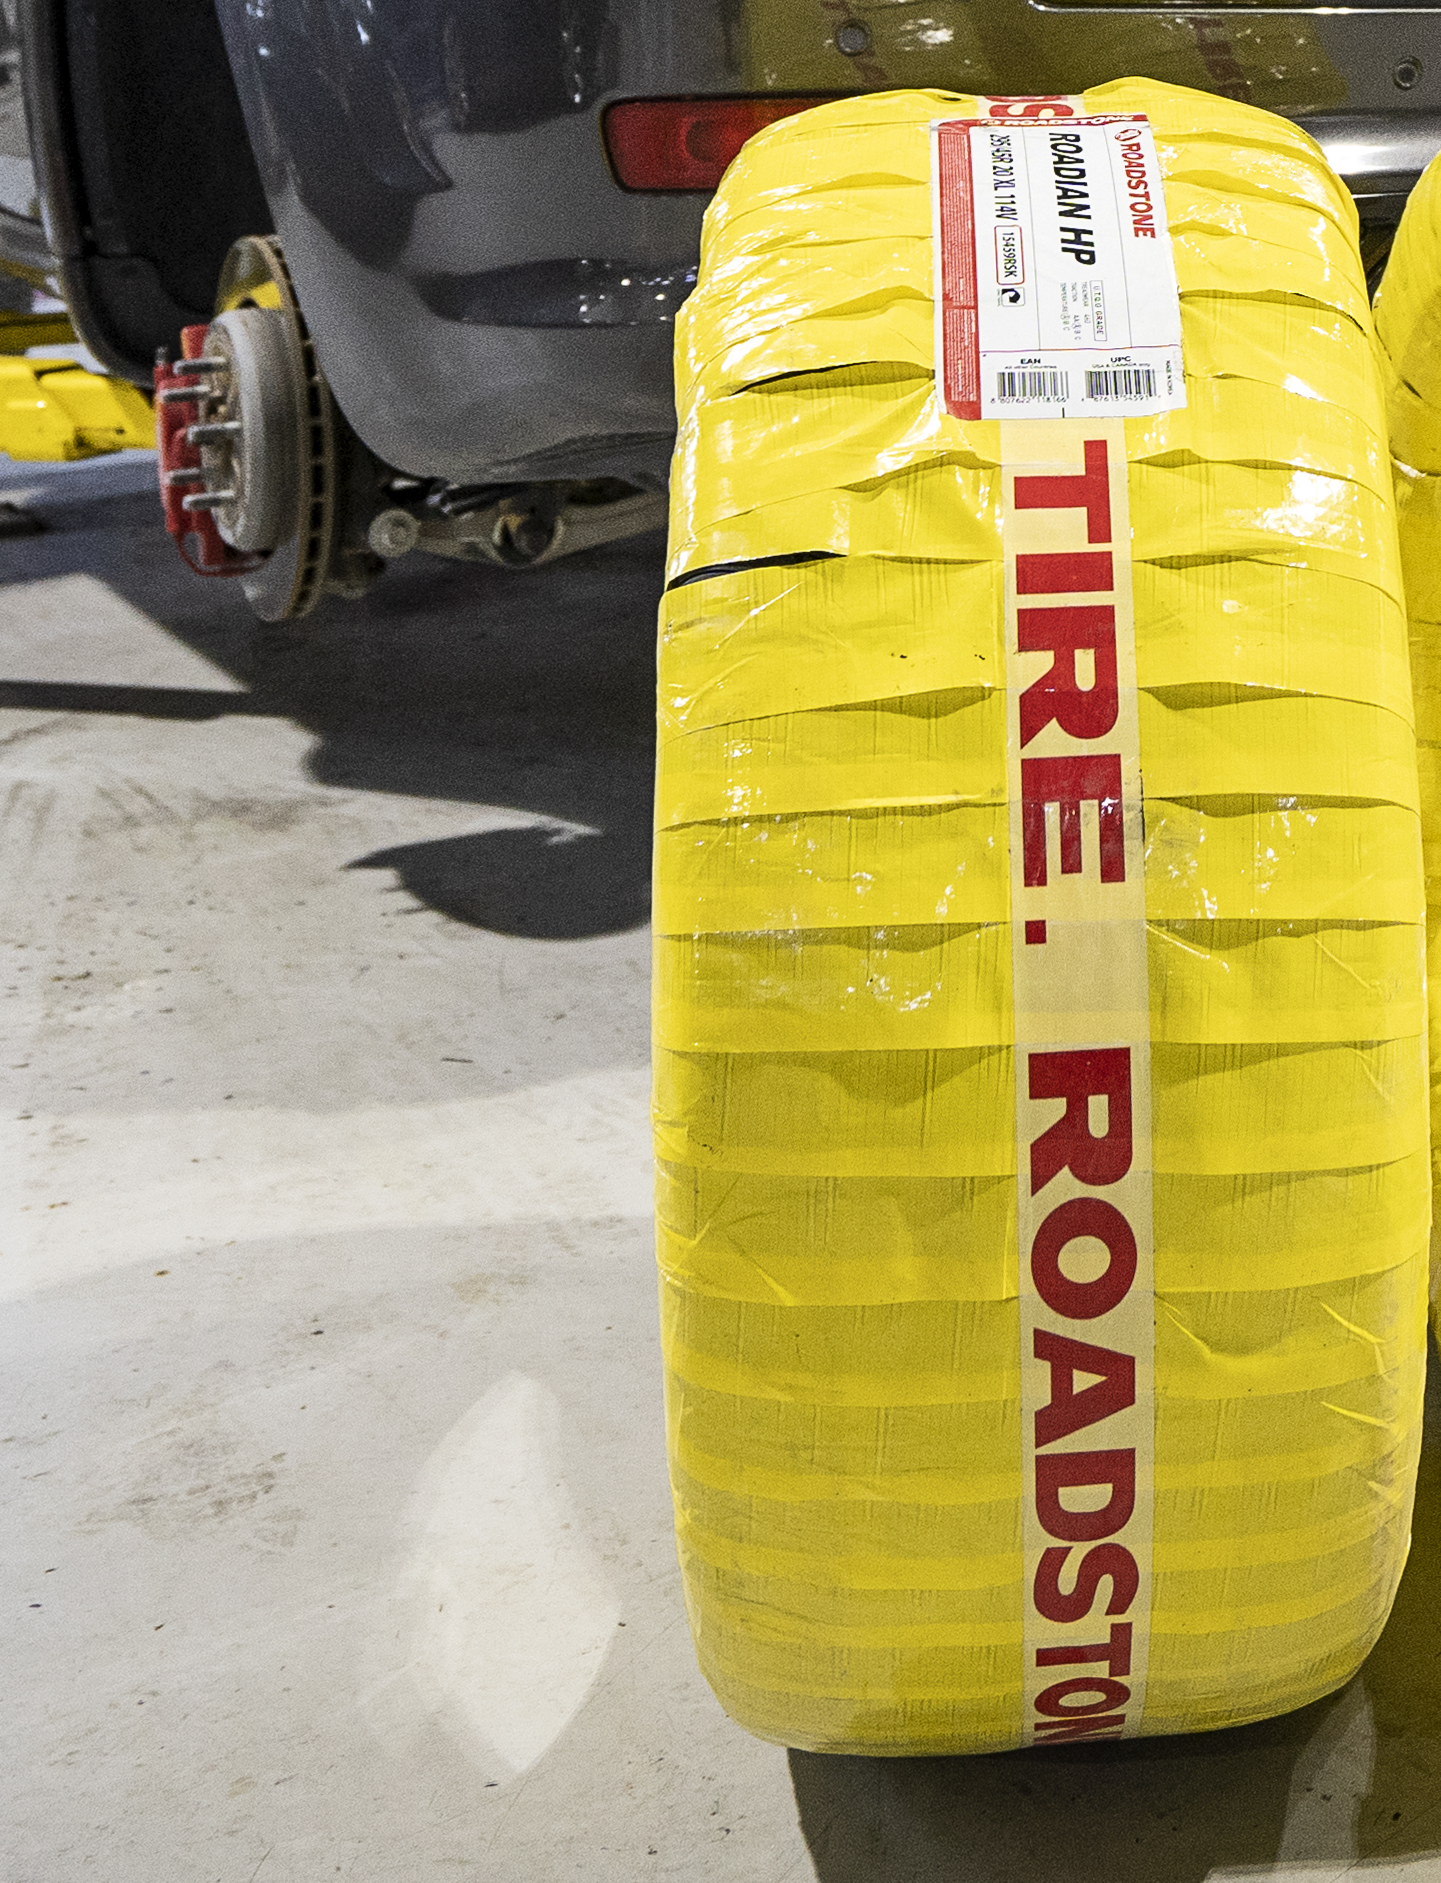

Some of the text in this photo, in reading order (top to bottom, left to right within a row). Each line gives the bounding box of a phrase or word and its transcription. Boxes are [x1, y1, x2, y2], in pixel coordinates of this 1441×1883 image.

[1003, 114, 1135, 128] ROADSTONE
[994, 194, 1018, 221] 114V
[1048, 131, 1097, 267] ROADIAN HP
[1120, 141, 1157, 239] ROADSTONE
[1002, 231, 1018, 279] 15459RSK
